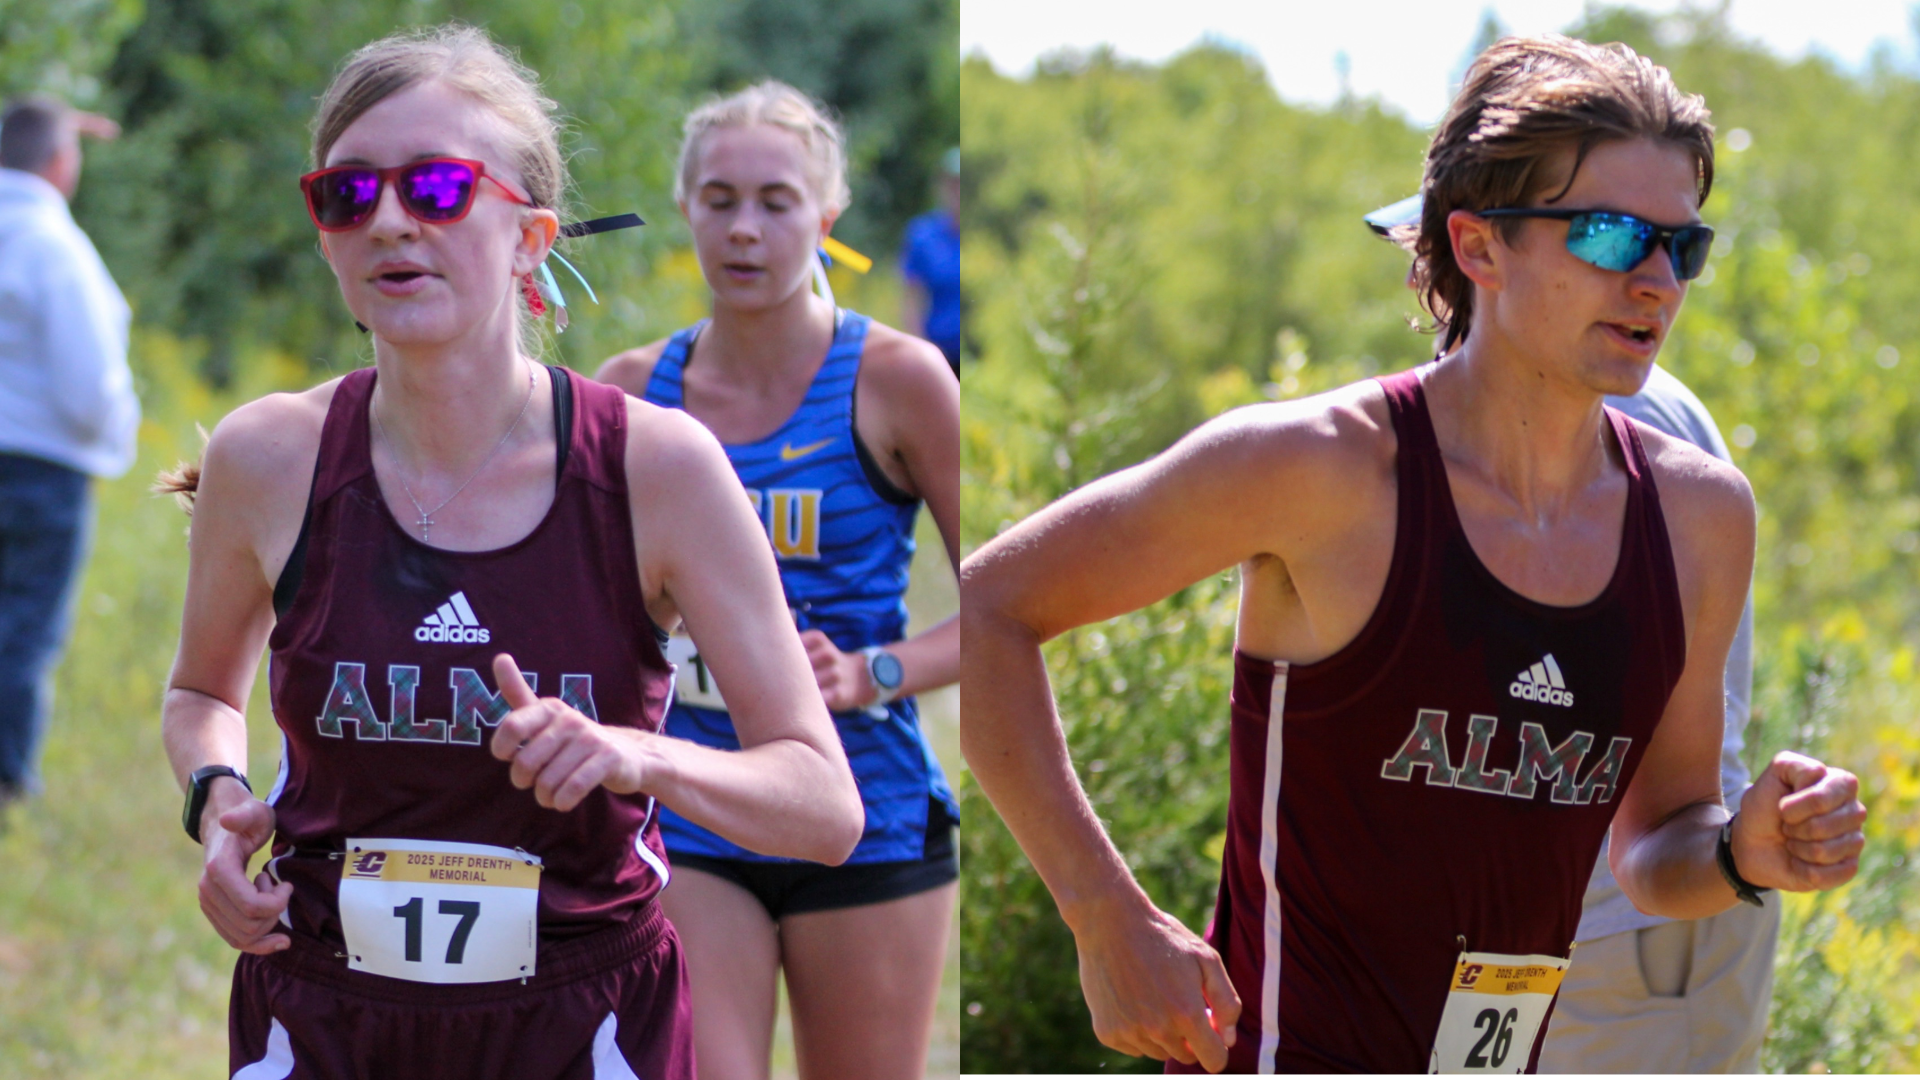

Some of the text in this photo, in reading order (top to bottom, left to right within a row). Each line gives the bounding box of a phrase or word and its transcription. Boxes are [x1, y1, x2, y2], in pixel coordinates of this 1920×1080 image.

[747, 488, 823, 559] U
[414, 623, 491, 644] adidas
[1509, 681, 1574, 707] adidas
[1380, 708, 1632, 805] ALMA
[407, 854, 513, 871] 2025 JEFF DRENTH
[429, 869, 487, 882] MEMORIAL
[393, 897, 481, 964] 17
[1464, 1007, 1518, 1068] 26
